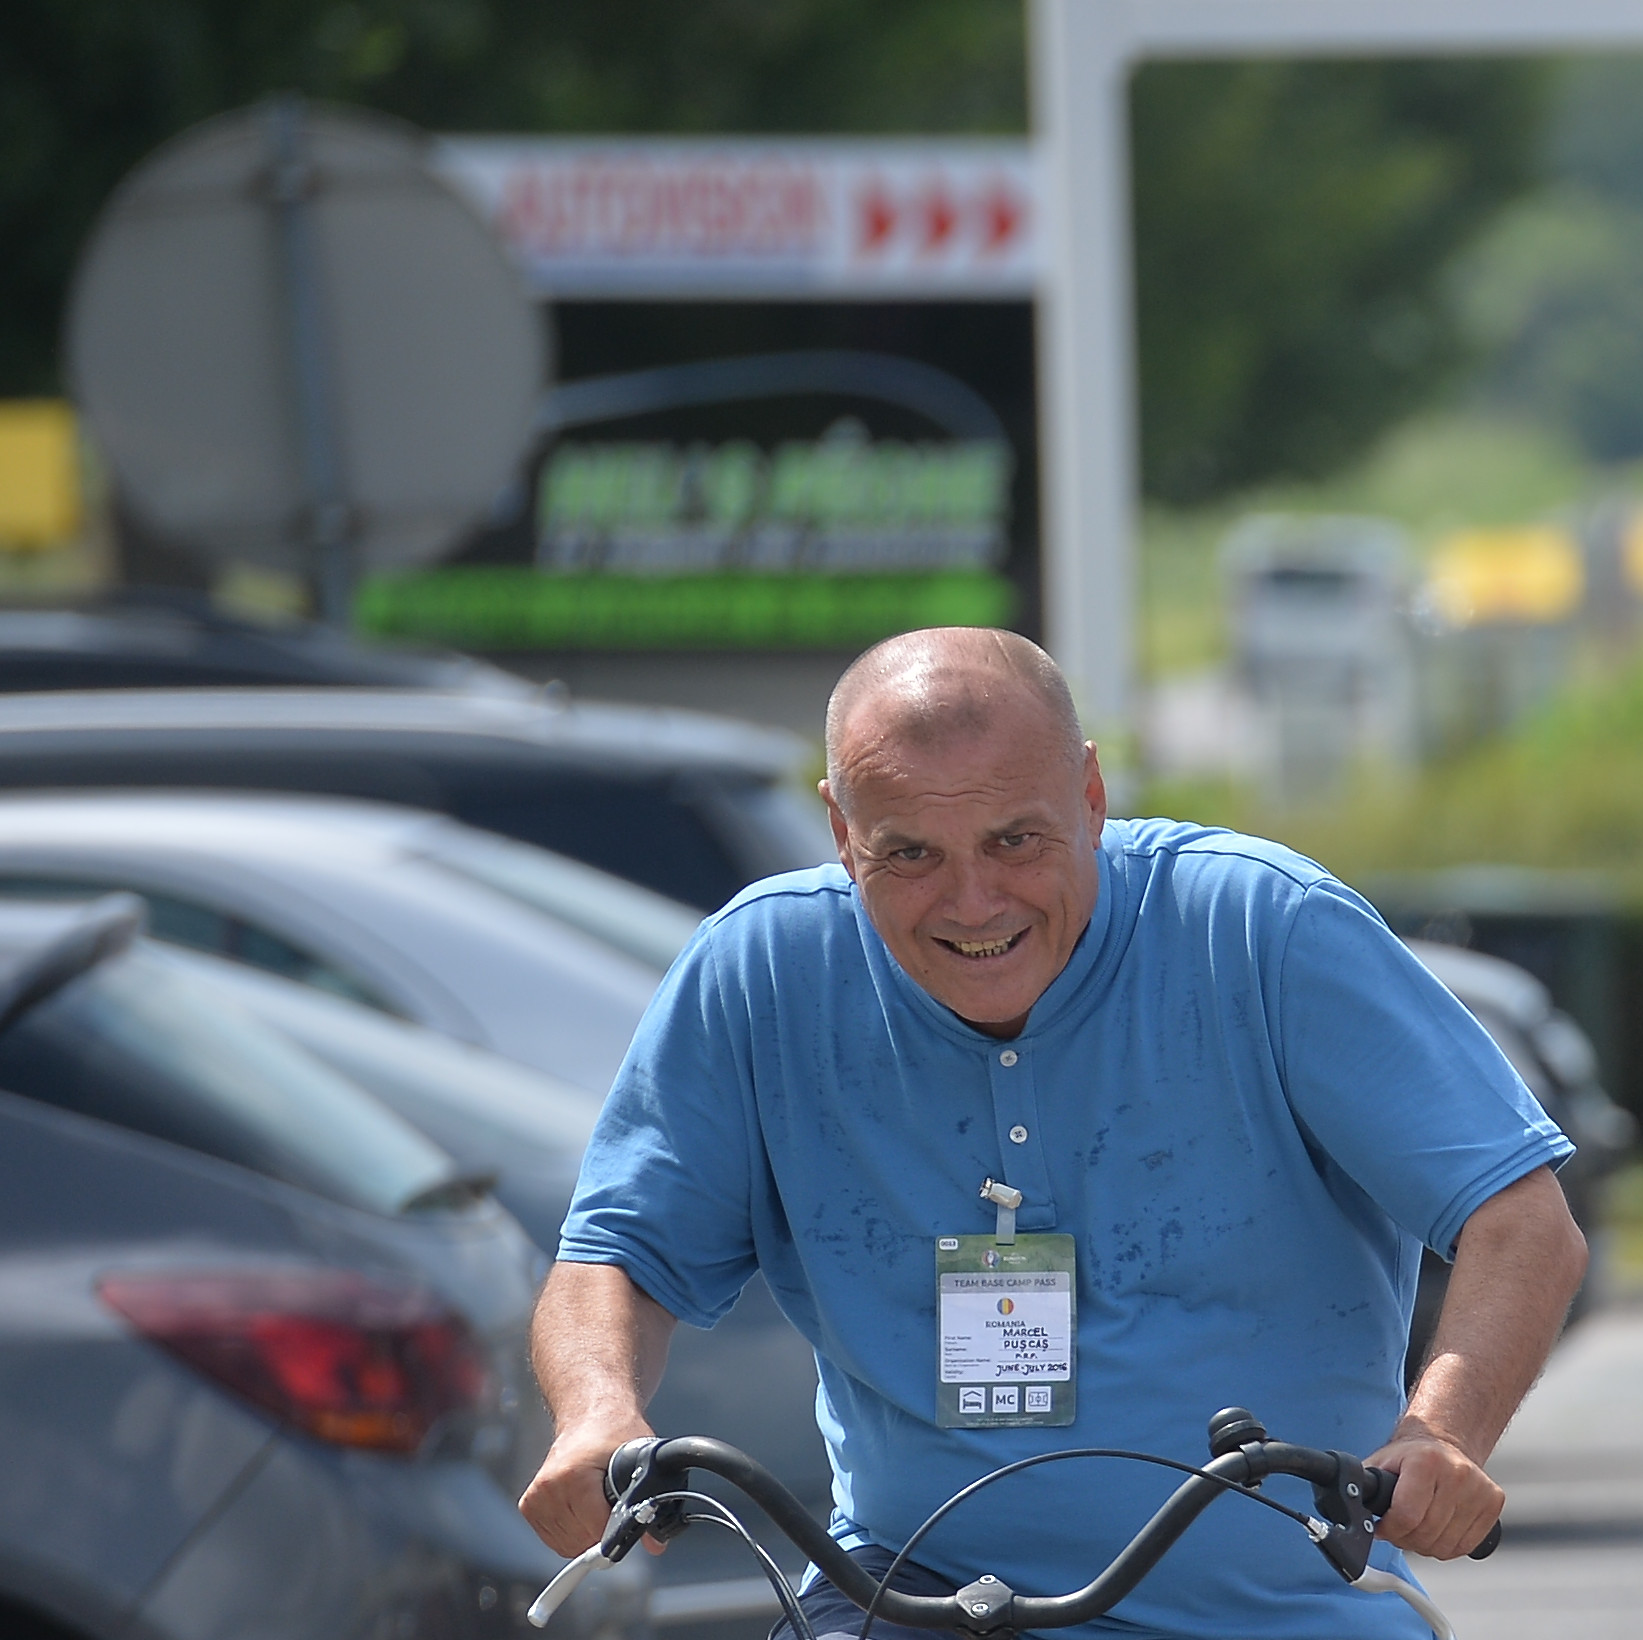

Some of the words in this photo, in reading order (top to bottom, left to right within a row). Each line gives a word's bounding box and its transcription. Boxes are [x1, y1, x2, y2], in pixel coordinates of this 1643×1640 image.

[955, 1279, 979, 1288] TEAM
[981, 1279, 1004, 1287] BASE
[1006, 1279, 1031, 1287] CAMP
[1034, 1278, 1057, 1286] PASS
[985, 1320, 1026, 1328] ROMANIA
[1003, 1327, 1049, 1337] MARCEL
[995, 1394, 1015, 1405] MC
